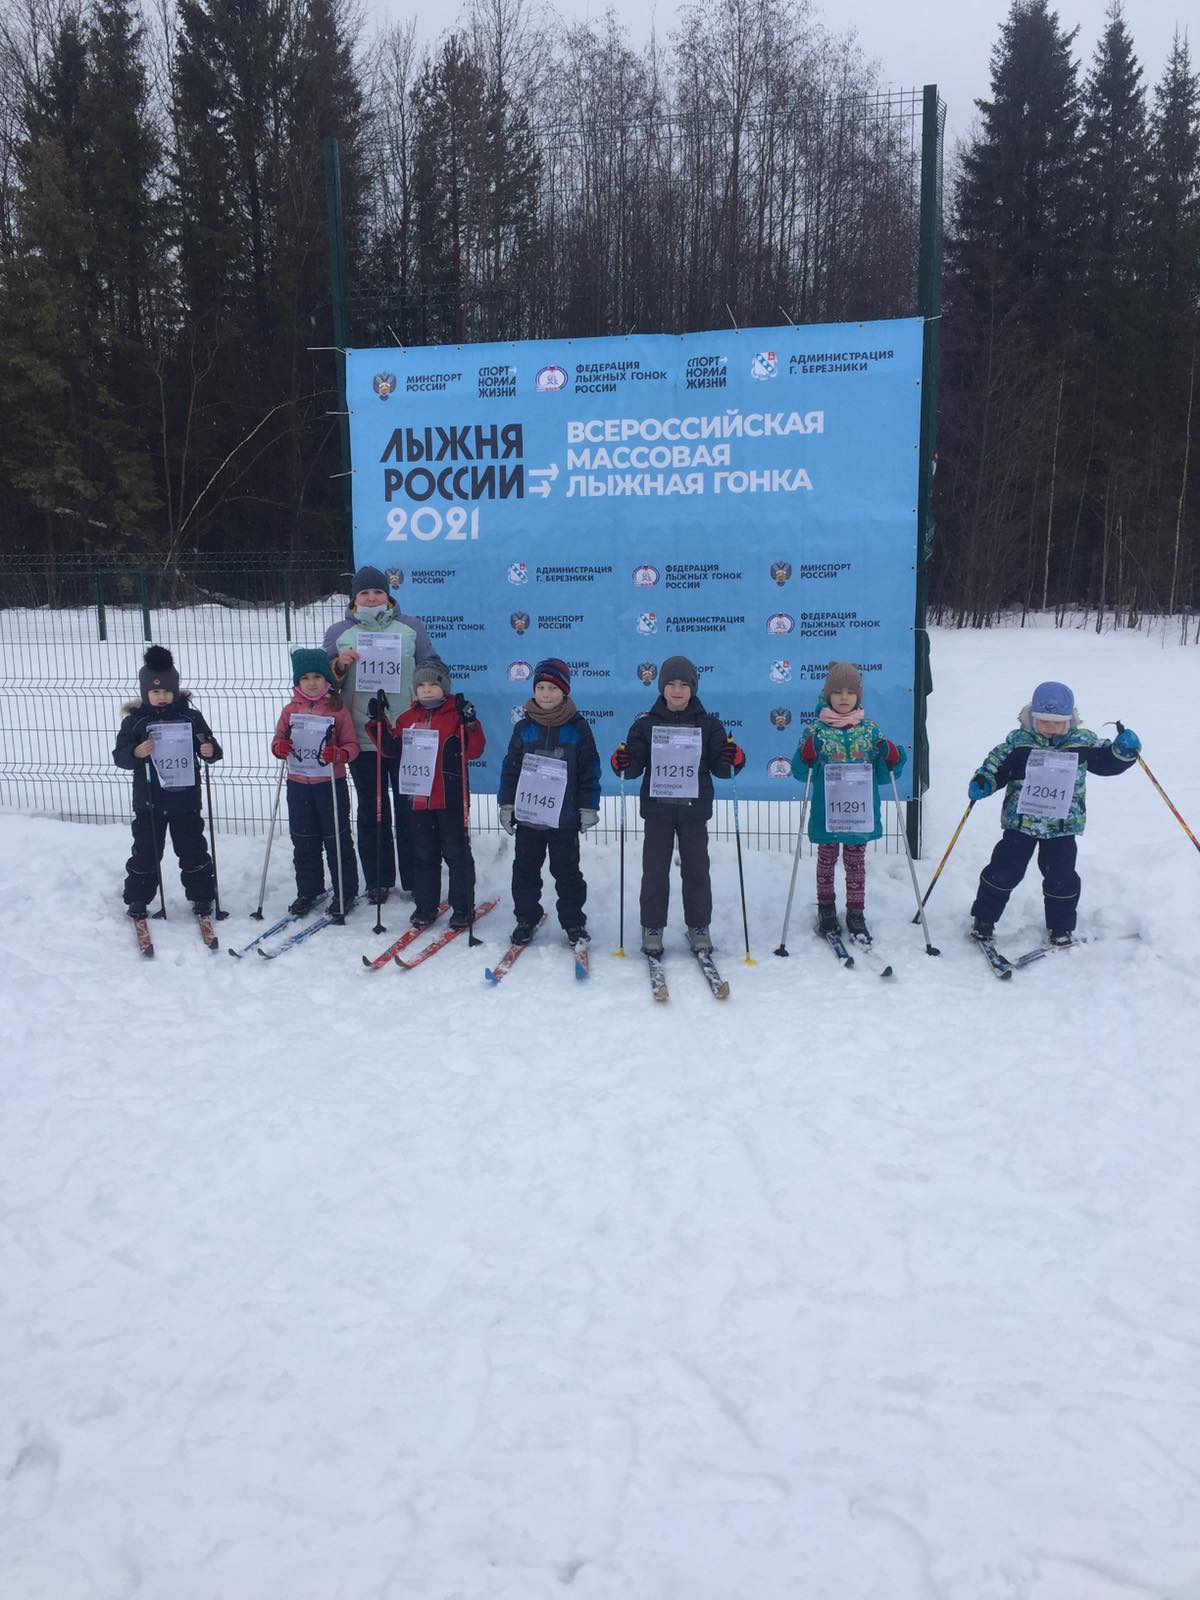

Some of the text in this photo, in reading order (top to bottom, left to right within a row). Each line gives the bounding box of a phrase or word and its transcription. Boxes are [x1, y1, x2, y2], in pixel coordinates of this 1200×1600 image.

[687, 355, 721, 367] СПОРТ
[789, 350, 895, 365] АДМИНИСТРАЦИЯ
[478, 366, 511, 377] СПОРТ
[575, 361, 640, 374] ФЕДЕРАЦИЯ
[686, 366, 728, 378] НОРМА
[789, 362, 868, 375] Г. БЕРЕЗНИКИ
[406, 373, 463, 384] МИНСПОРТ
[478, 376, 517, 388] НОРМА
[575, 371, 668, 383] ЛЫЖНЫХ ГОНОК
[406, 383, 447, 393] РОССИИ
[575, 383, 617, 394] РОССИИ
[686, 377, 727, 389] ЖИЗНИ
[478, 387, 517, 399] ЖИЗНИ
[566, 408, 825, 444] ВСЕРОССИЙСКАЯ
[379, 423, 524, 464] ЛЫЖНЯ
[566, 443, 732, 471] МАССОВАЯ
[383, 464, 525, 503] РОССИИ
[565, 467, 814, 498] ЛЫЖНАЯ ГОНКА
[385, 505, 480, 542] 2021
[536, 566, 613, 575] АДМИНИСТРАЦИЯ
[665, 564, 719, 574] ФЕДЕРАЦИЯ
[800, 563, 851, 571] МИНСПОРТ
[411, 570, 456, 578] МИНСПОРТ
[536, 574, 594, 583] Г. БЕРЕЗНИКИ
[665, 572, 742, 581] ЛЫЖНЫХ ГОНОК
[800, 571, 837, 579] РОССИИ
[412, 577, 445, 585] РОССИИ
[665, 581, 700, 589] РОССИИ
[537, 615, 584, 623] МИНСПОРТ
[666, 615, 745, 625] АДМИНИСТРАЦИЯ
[800, 612, 857, 621] ФЕДЕРАЦИЯ
[457, 623, 485, 631] ГОНОК
[538, 622, 572, 630] РОССИИ
[676, 624, 726, 632] БЕРЕЗНИКИ
[800, 619, 880, 629] ЛЫЖНЫХ ГОНОК
[800, 629, 837, 638] РОССИИ
[582, 669, 611, 677] ГОНОК
[401, 764, 431, 777] 11213
[655, 765, 694, 778] 11215
[1026, 785, 1066, 801] 12041
[520, 791, 556, 809] 11145
[829, 801, 866, 813] 11291
